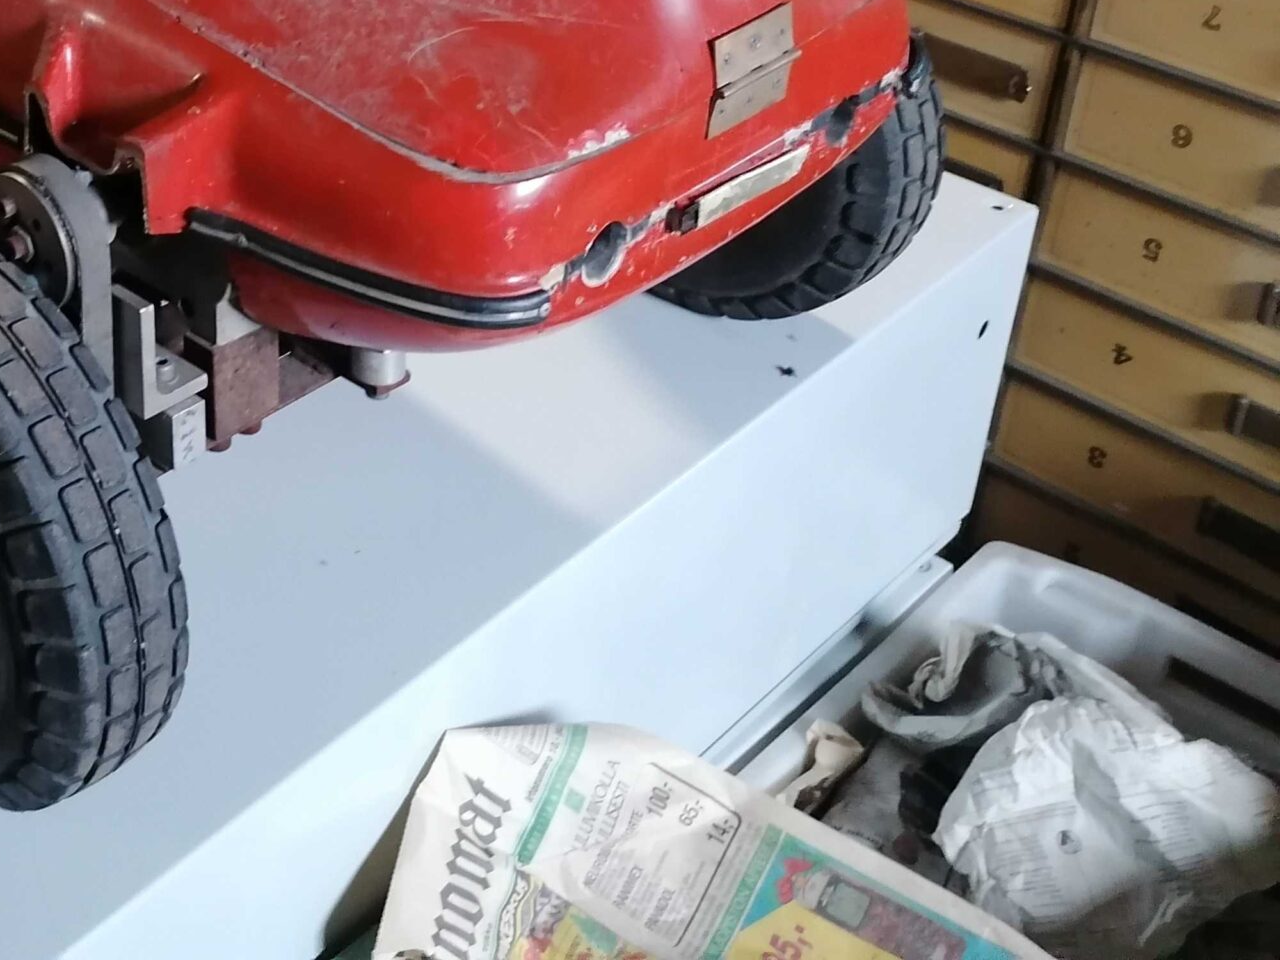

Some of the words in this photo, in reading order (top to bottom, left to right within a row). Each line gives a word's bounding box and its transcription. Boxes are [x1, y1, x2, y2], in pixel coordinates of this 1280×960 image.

[1202, 4, 1221, 31] 7
[1171, 123, 1193, 148] 6
[1142, 238, 1163, 263] 5
[1112, 343, 1133, 365] 4
[1087, 446, 1107, 469] 3
